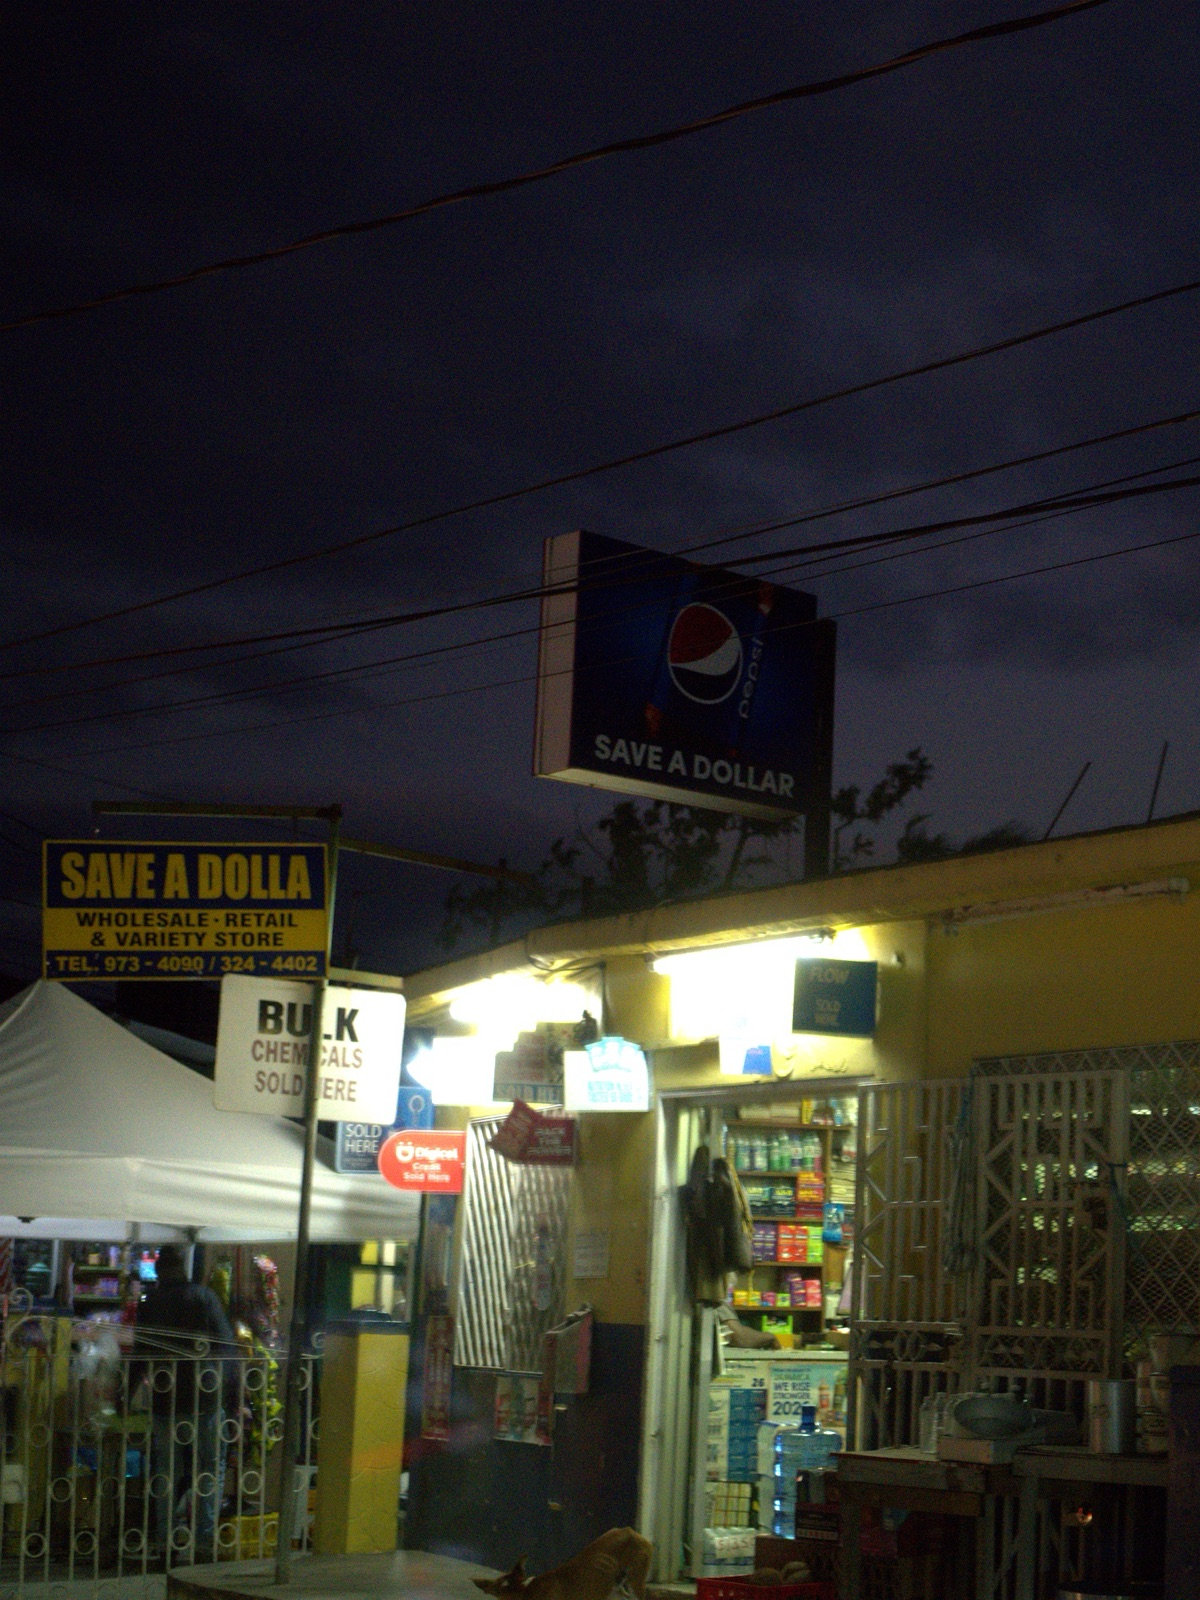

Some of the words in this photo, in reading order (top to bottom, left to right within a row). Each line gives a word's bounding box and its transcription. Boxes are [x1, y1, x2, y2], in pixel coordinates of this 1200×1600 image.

[738, 636, 764, 720] pepsi
[594, 734, 663, 770] SAVE
[667, 750, 688, 777] A
[693, 755, 795, 797] DOLLAR
[60, 852, 157, 900] SAVE
[163, 853, 190, 899] A
[198, 853, 312, 900] DOLLA
[77, 912, 208, 928] WHOLESALE
[225, 913, 298, 928] RETAIL
[91, 932, 105, 946] &
[115, 932, 207, 946] VARIETY
[215, 932, 285, 947] STORE
[56, 956, 99, 972] TEL.
[258, 999, 359, 1043] BUK
[251, 1038, 363, 1069] CHEMCALS
[255, 1071, 303, 1097] SOLD
[322, 1077, 357, 1102] ERE
[345, 1124, 382, 1138] SOLD
[345, 1139, 379, 1153] HERE
[415, 1147, 458, 1161] Digicel
[412, 1162, 441, 1171] Credit
[403, 1172, 425, 1181] Sold
[427, 1173, 451, 1183] Here
[773, 1382, 790, 1391] WE
[773, 1401, 809, 1416] 202
